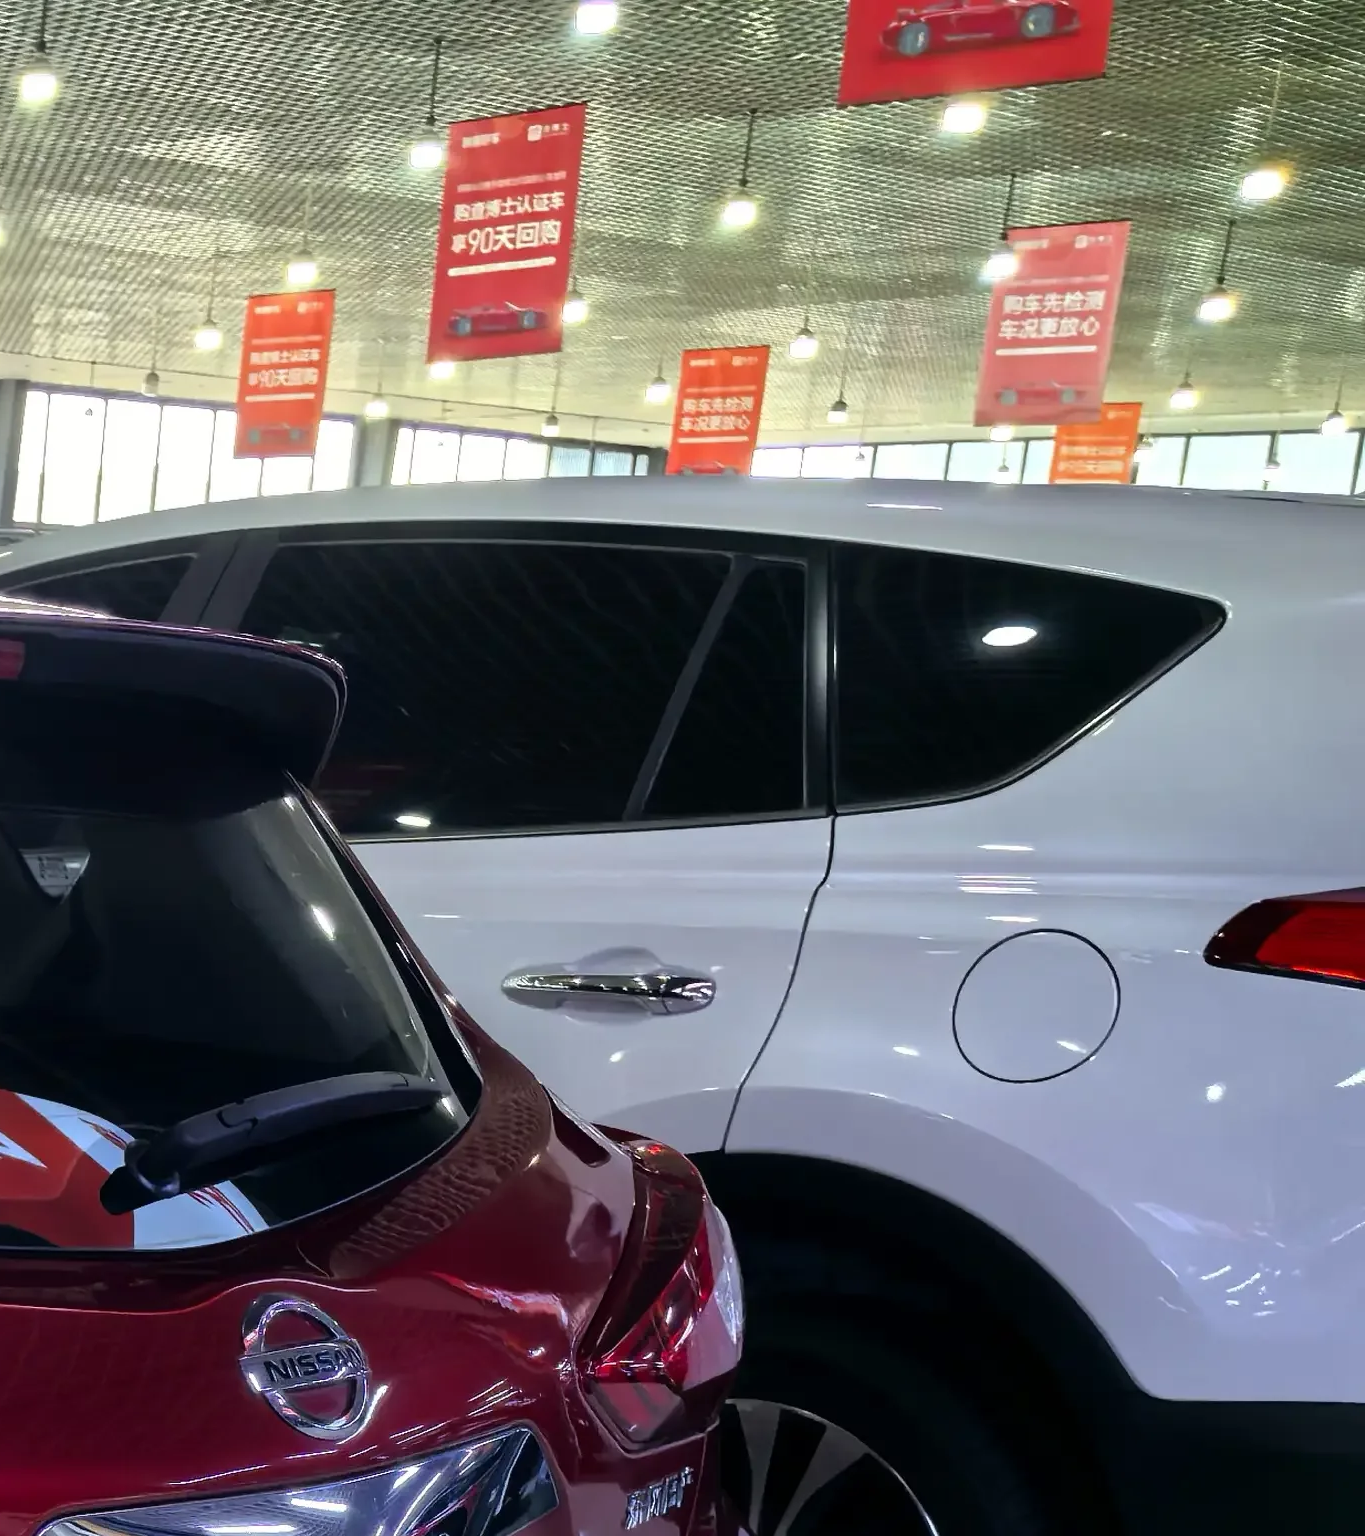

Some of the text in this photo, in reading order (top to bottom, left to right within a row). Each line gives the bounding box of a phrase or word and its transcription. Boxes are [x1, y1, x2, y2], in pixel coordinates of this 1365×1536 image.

[451, 219, 562, 255] 享90天回购
[998, 316, 1101, 340] 车况更放心
[262, 1346, 364, 1383] NISSAN
